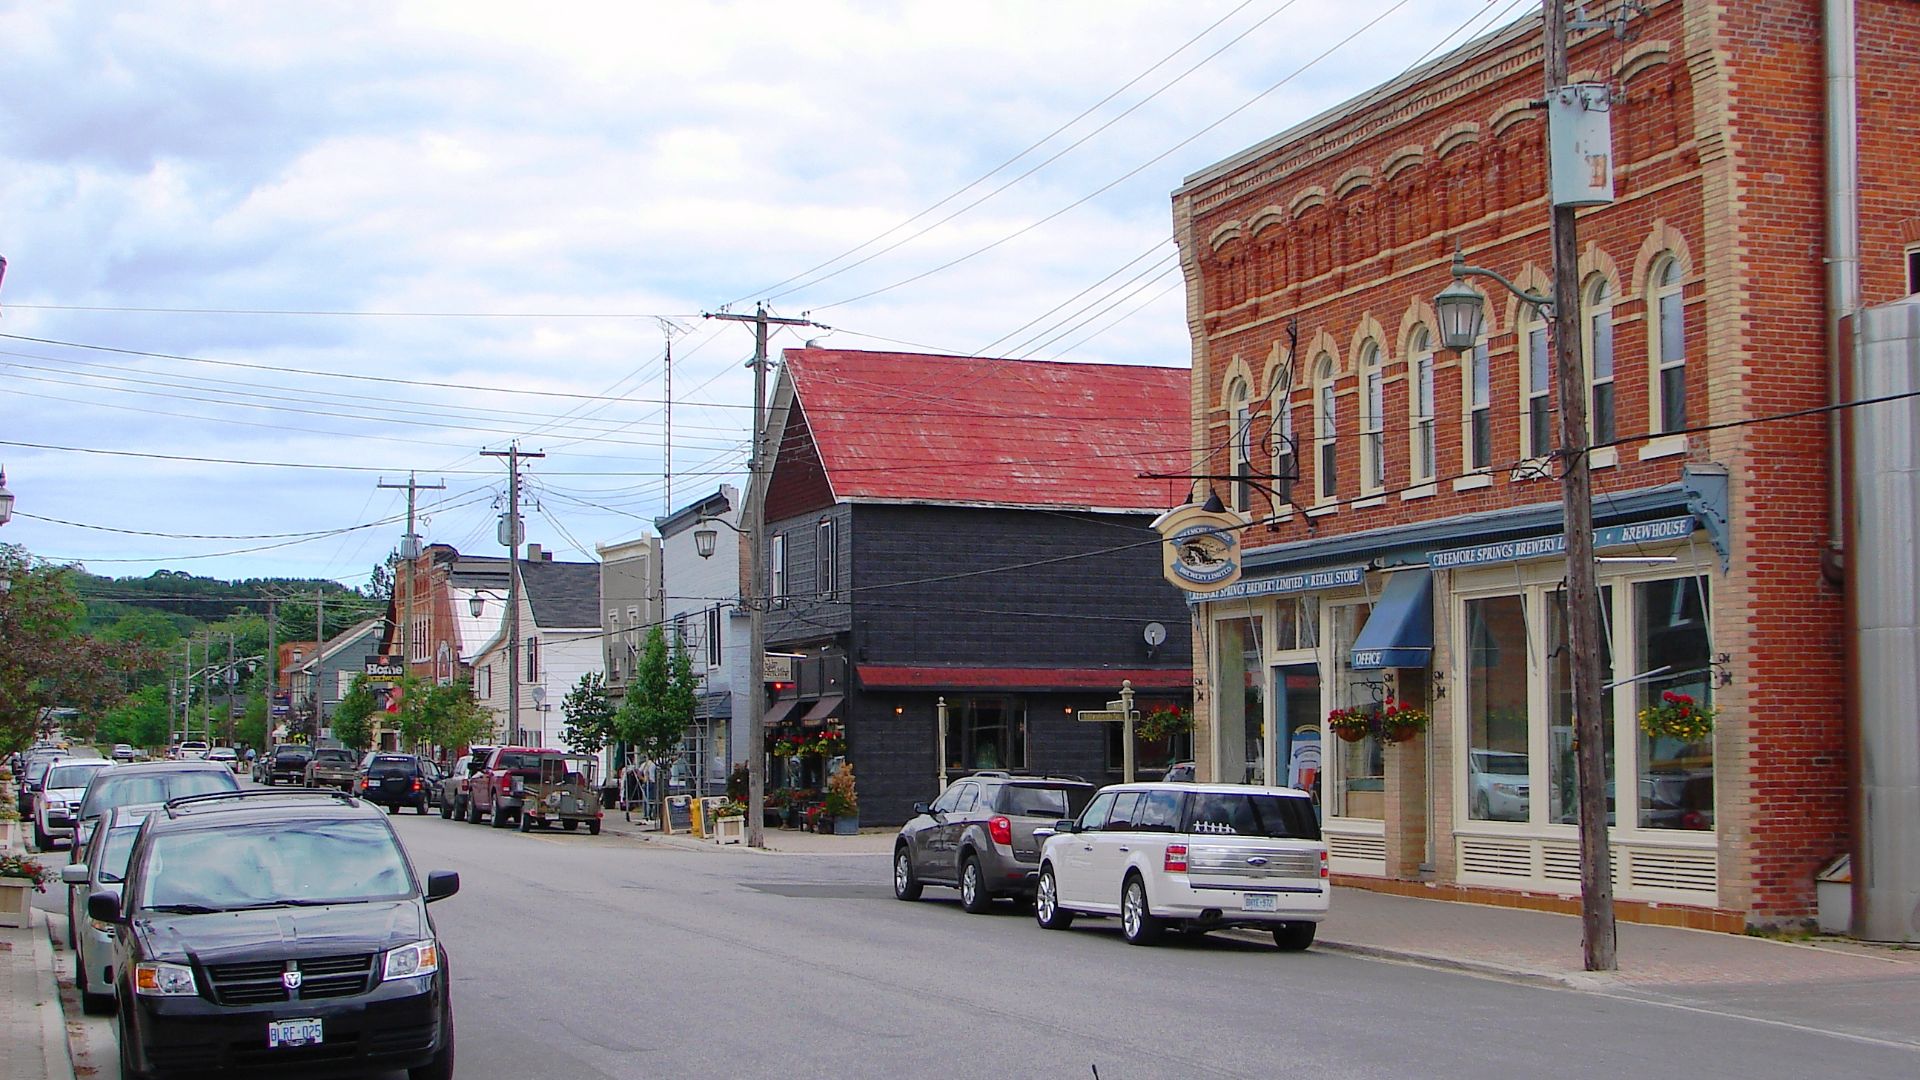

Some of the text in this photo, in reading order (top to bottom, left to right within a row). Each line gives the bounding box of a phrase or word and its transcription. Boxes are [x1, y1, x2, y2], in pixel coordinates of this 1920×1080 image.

[1622, 520, 1686, 541] BREWHOUSE
[1433, 551, 1475, 566] CREEMORE
[1477, 544, 1513, 561] SPRINGS
[1516, 538, 1556, 556] BREWERY
[1220, 583, 1245, 598] SPRINGS
[1246, 580, 1275, 595] BREWERY
[1276, 576, 1303, 591] LIMITED
[1311, 572, 1334, 587] RETAIL
[1335, 569, 1359, 584] STORE
[366, 663, 404, 675] Home
[1355, 652, 1381, 665] OFFICE
